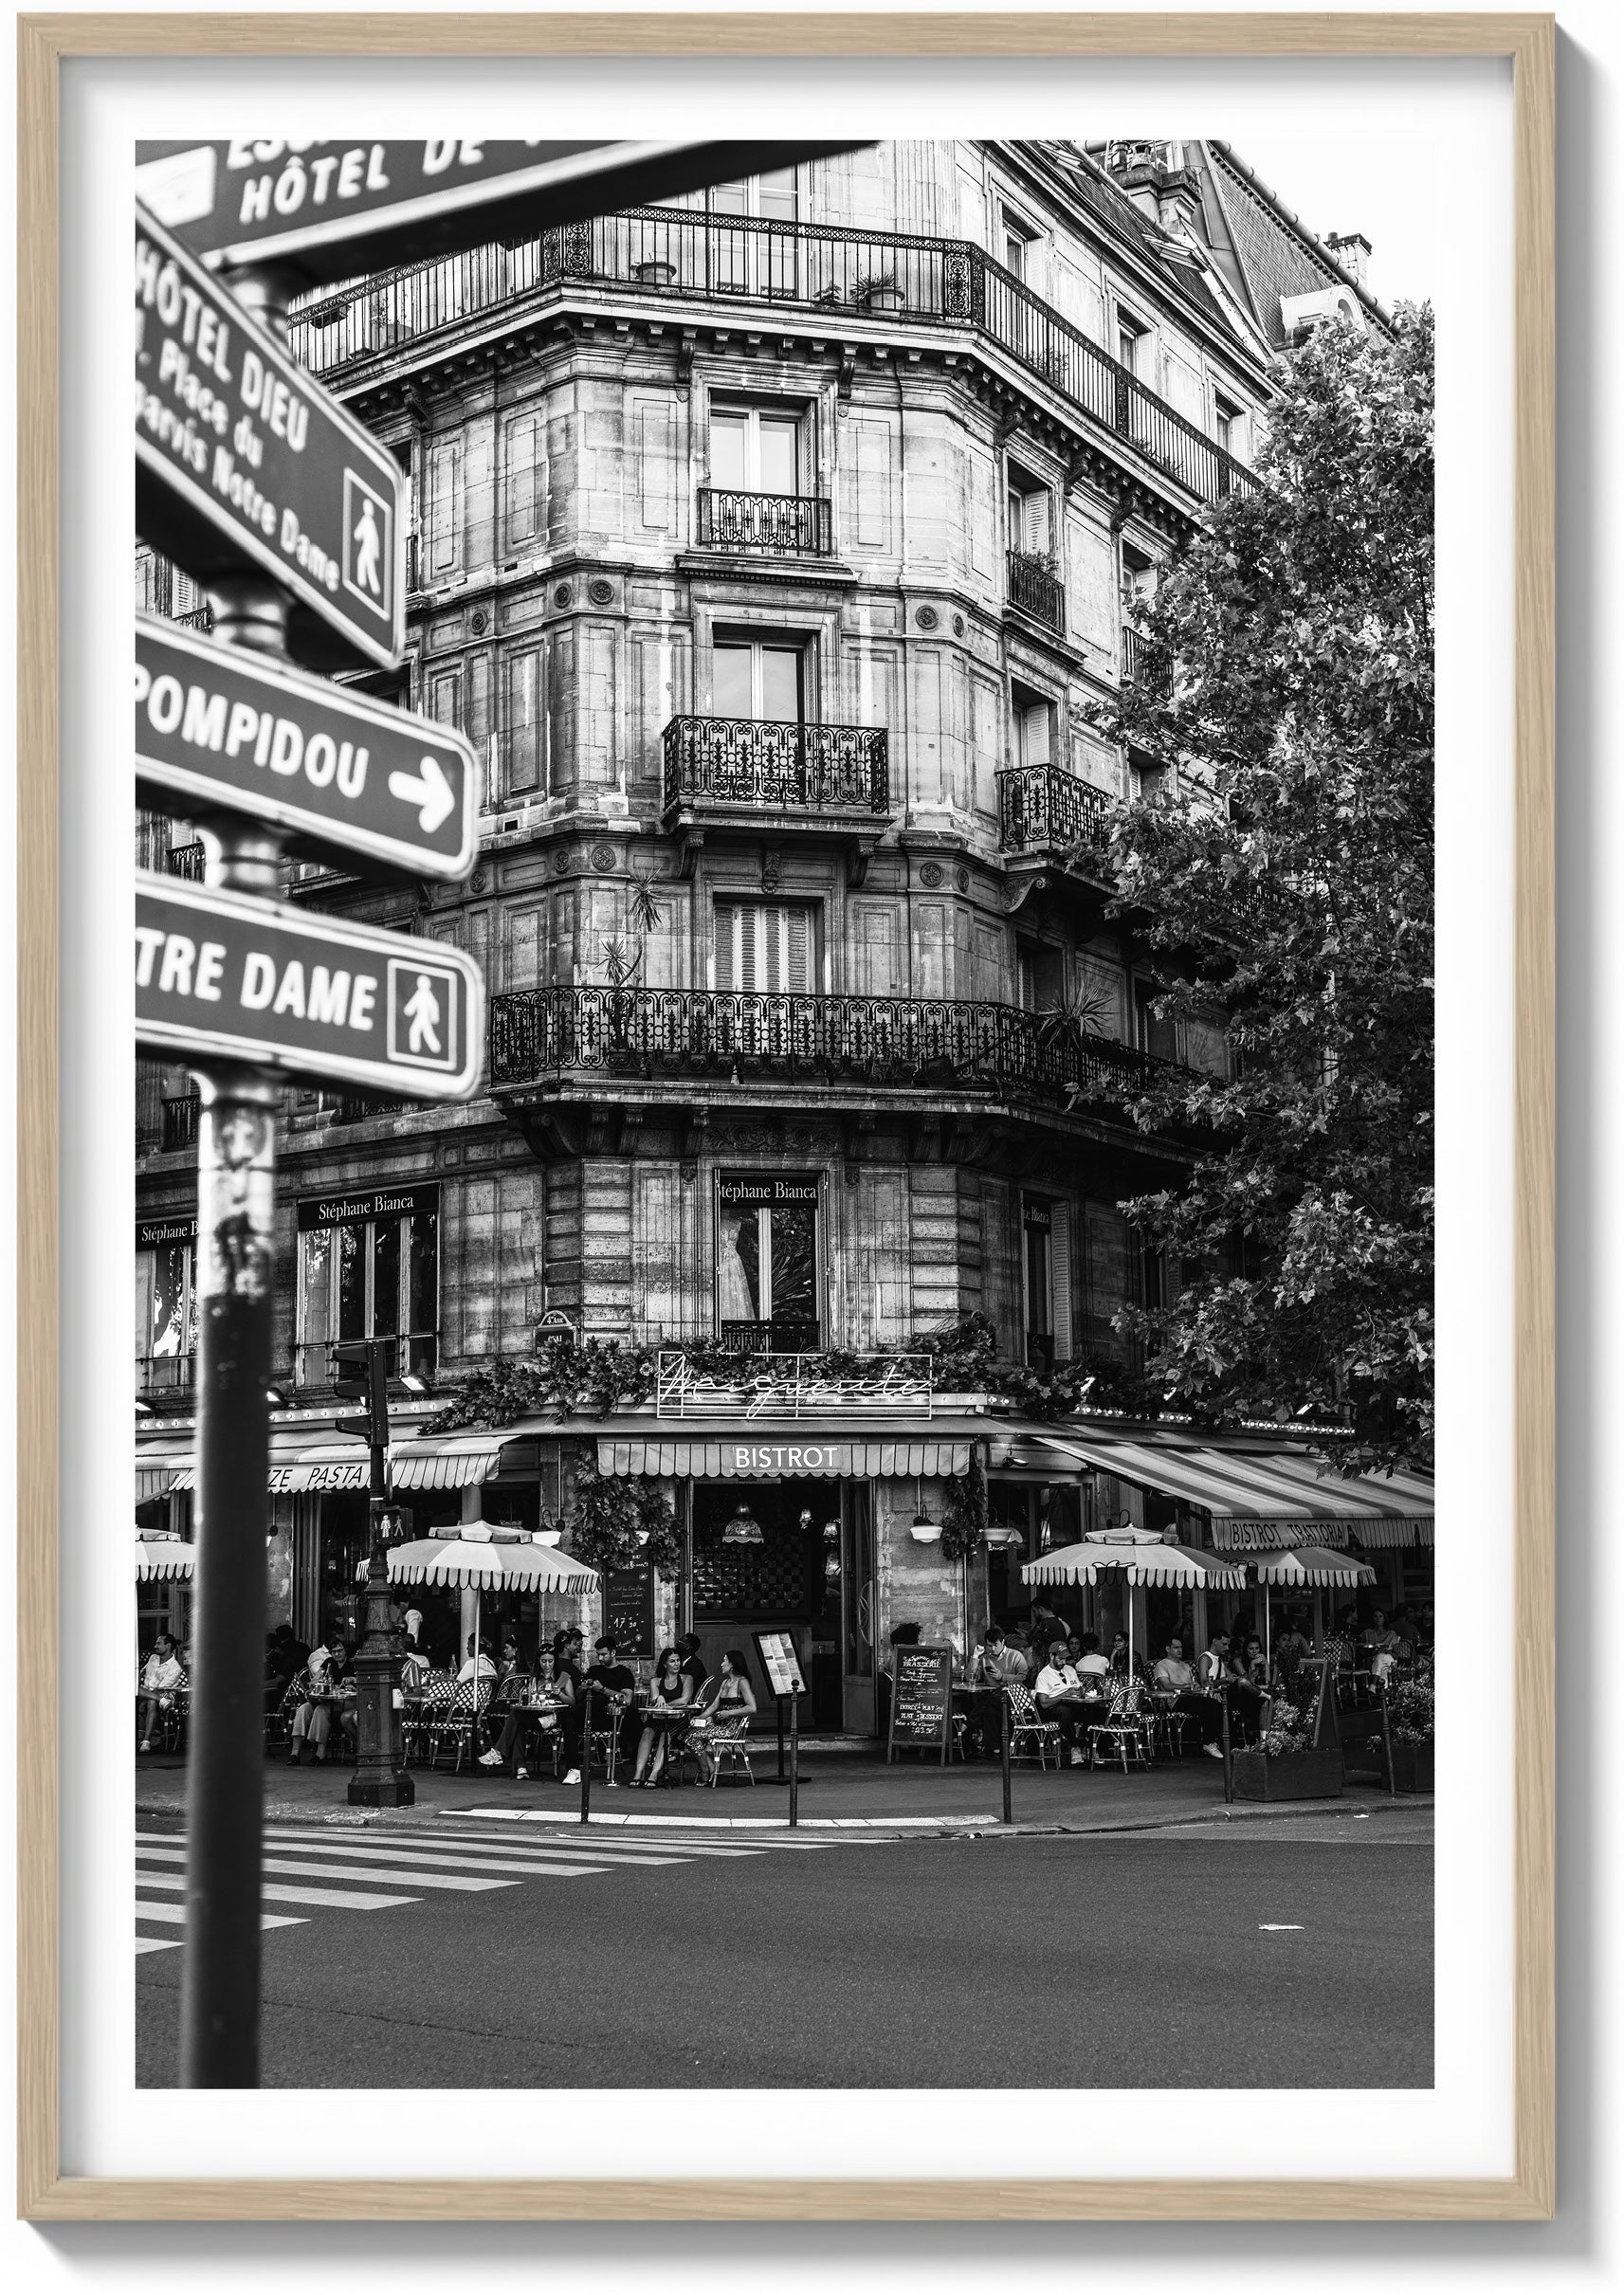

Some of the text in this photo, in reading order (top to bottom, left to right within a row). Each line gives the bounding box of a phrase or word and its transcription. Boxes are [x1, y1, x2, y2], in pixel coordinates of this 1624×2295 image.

[239, 143, 391, 226] HÔTEL
[158, 337, 229, 436] Place
[233, 414, 264, 469] du
[240, 349, 309, 453] DIEU
[211, 445, 278, 537] Notre
[281, 507, 339, 592] Dame
[239, 951, 378, 1031] DAME
[720, 1180, 817, 1202] téphane Bianca
[319, 1194, 414, 1221] Stéphane Bianca
[141, 1224, 188, 1244] Stéphane
[736, 1447, 838, 1468] BISTROT
[267, 1466, 362, 1487] ZE PASTA
[1232, 1522, 1344, 1544] BISTROT TRATTORIA
